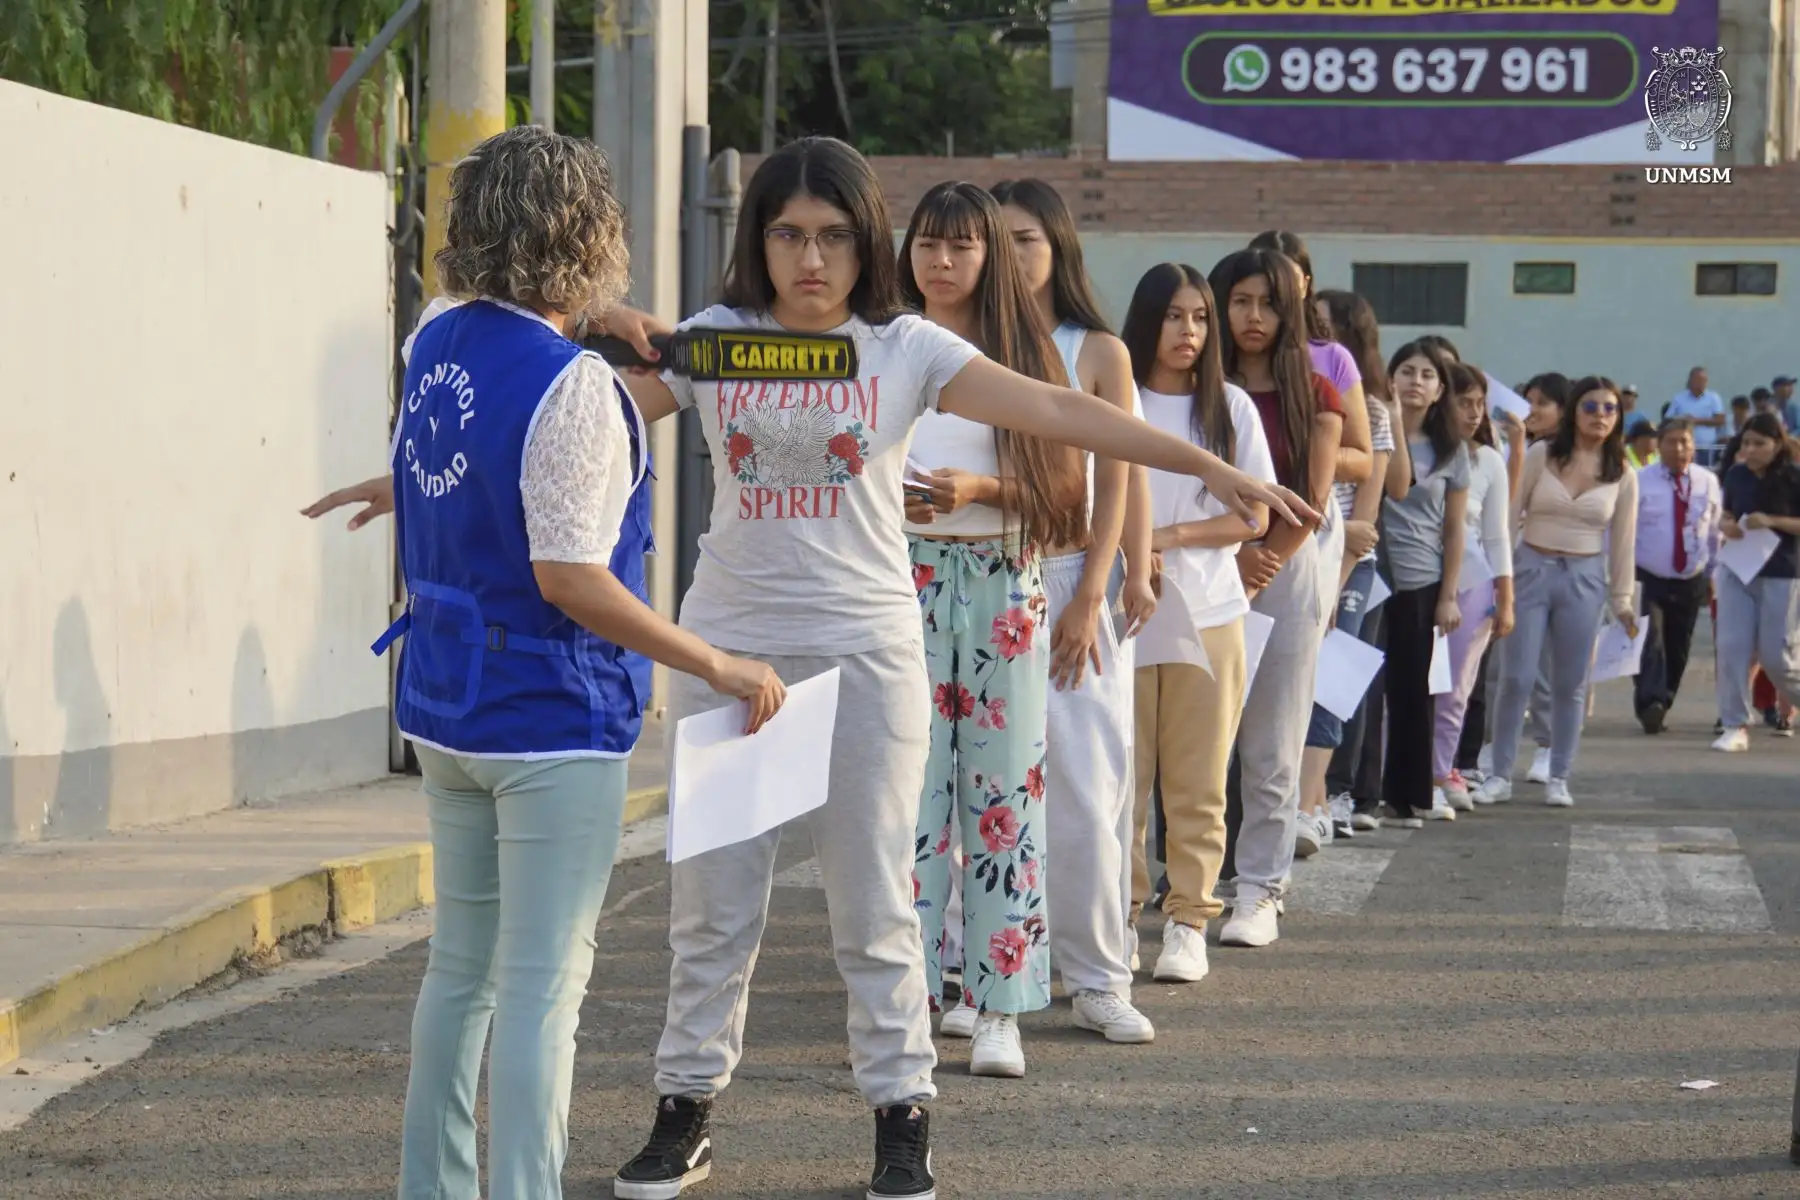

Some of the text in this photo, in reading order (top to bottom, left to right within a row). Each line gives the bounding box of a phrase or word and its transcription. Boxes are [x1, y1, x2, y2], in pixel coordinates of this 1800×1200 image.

[1280, 47, 1588, 93] 983 637 961
[731, 343, 839, 373] GARRETT
[408, 363, 475, 430] CONTROL
[716, 375, 880, 433] FREEDOM
[429, 416, 439, 441] Y
[406, 438, 468, 498] CALIDAD
[739, 486, 846, 520] SPIRIT
